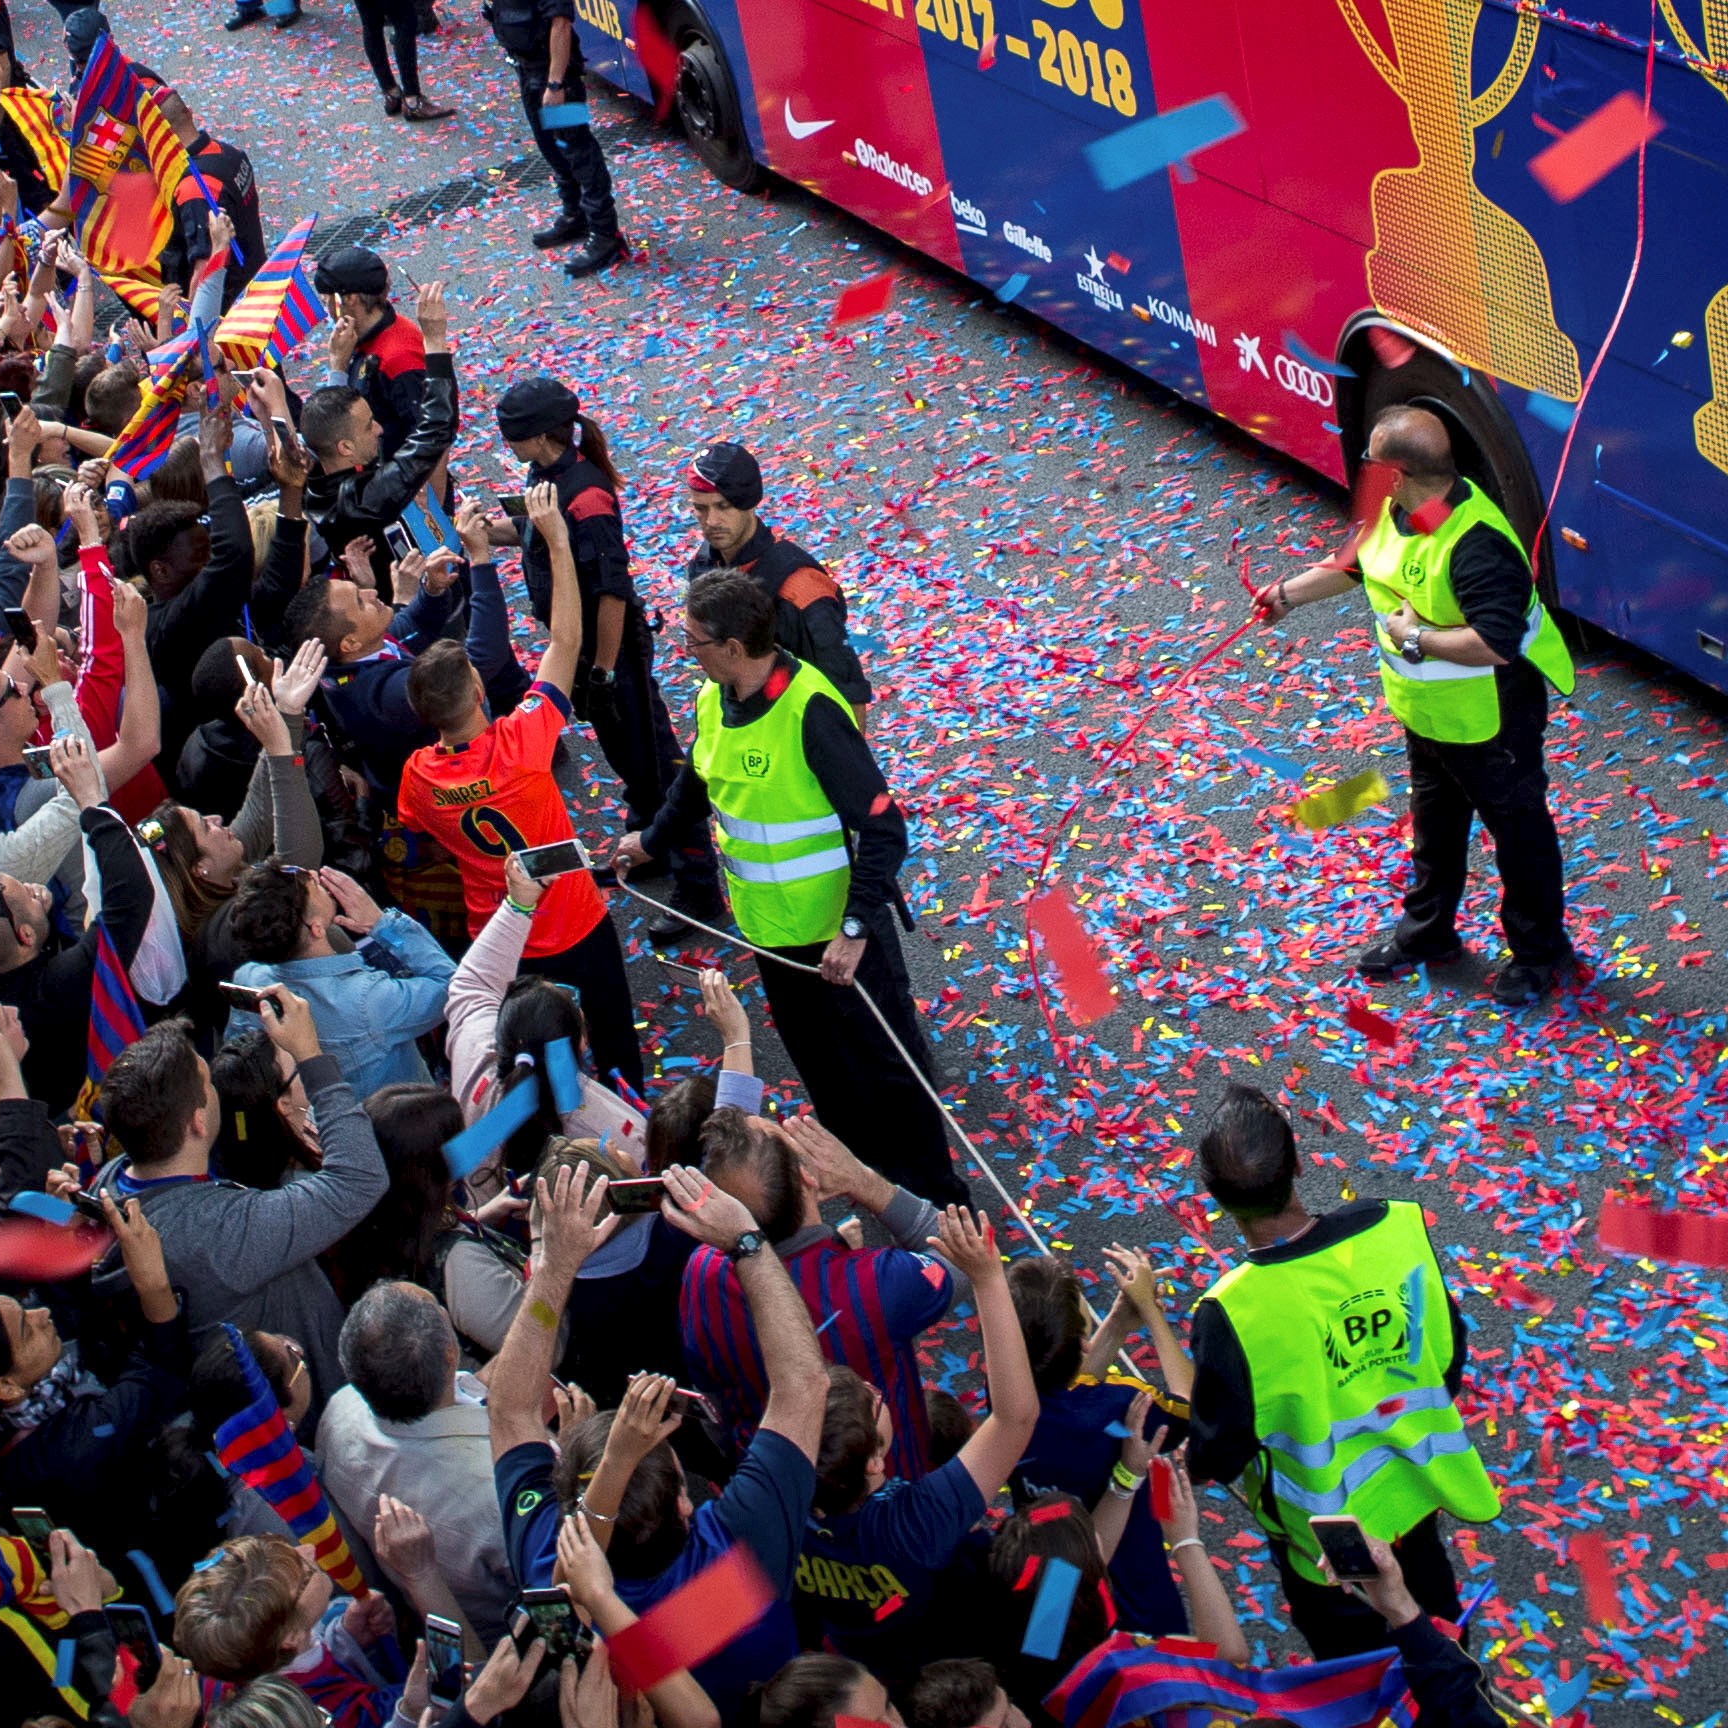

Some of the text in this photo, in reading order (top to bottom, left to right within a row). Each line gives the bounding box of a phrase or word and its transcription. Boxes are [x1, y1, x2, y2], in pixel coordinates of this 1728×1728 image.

[1032, 19, 1138, 118] 2018
[867, 143, 933, 198] Rakuten
[950, 190, 987, 228] beko
[1003, 219, 1053, 264] Gillette
[1076, 271, 1125, 311] ESTRELLA
[1147, 294, 1218, 348] KONAMI
[748, 755, 762, 769] BP
[459, 805, 530, 858] 9
[1343, 1308, 1392, 1348] BP
[794, 1552, 911, 1609] BARÇA
